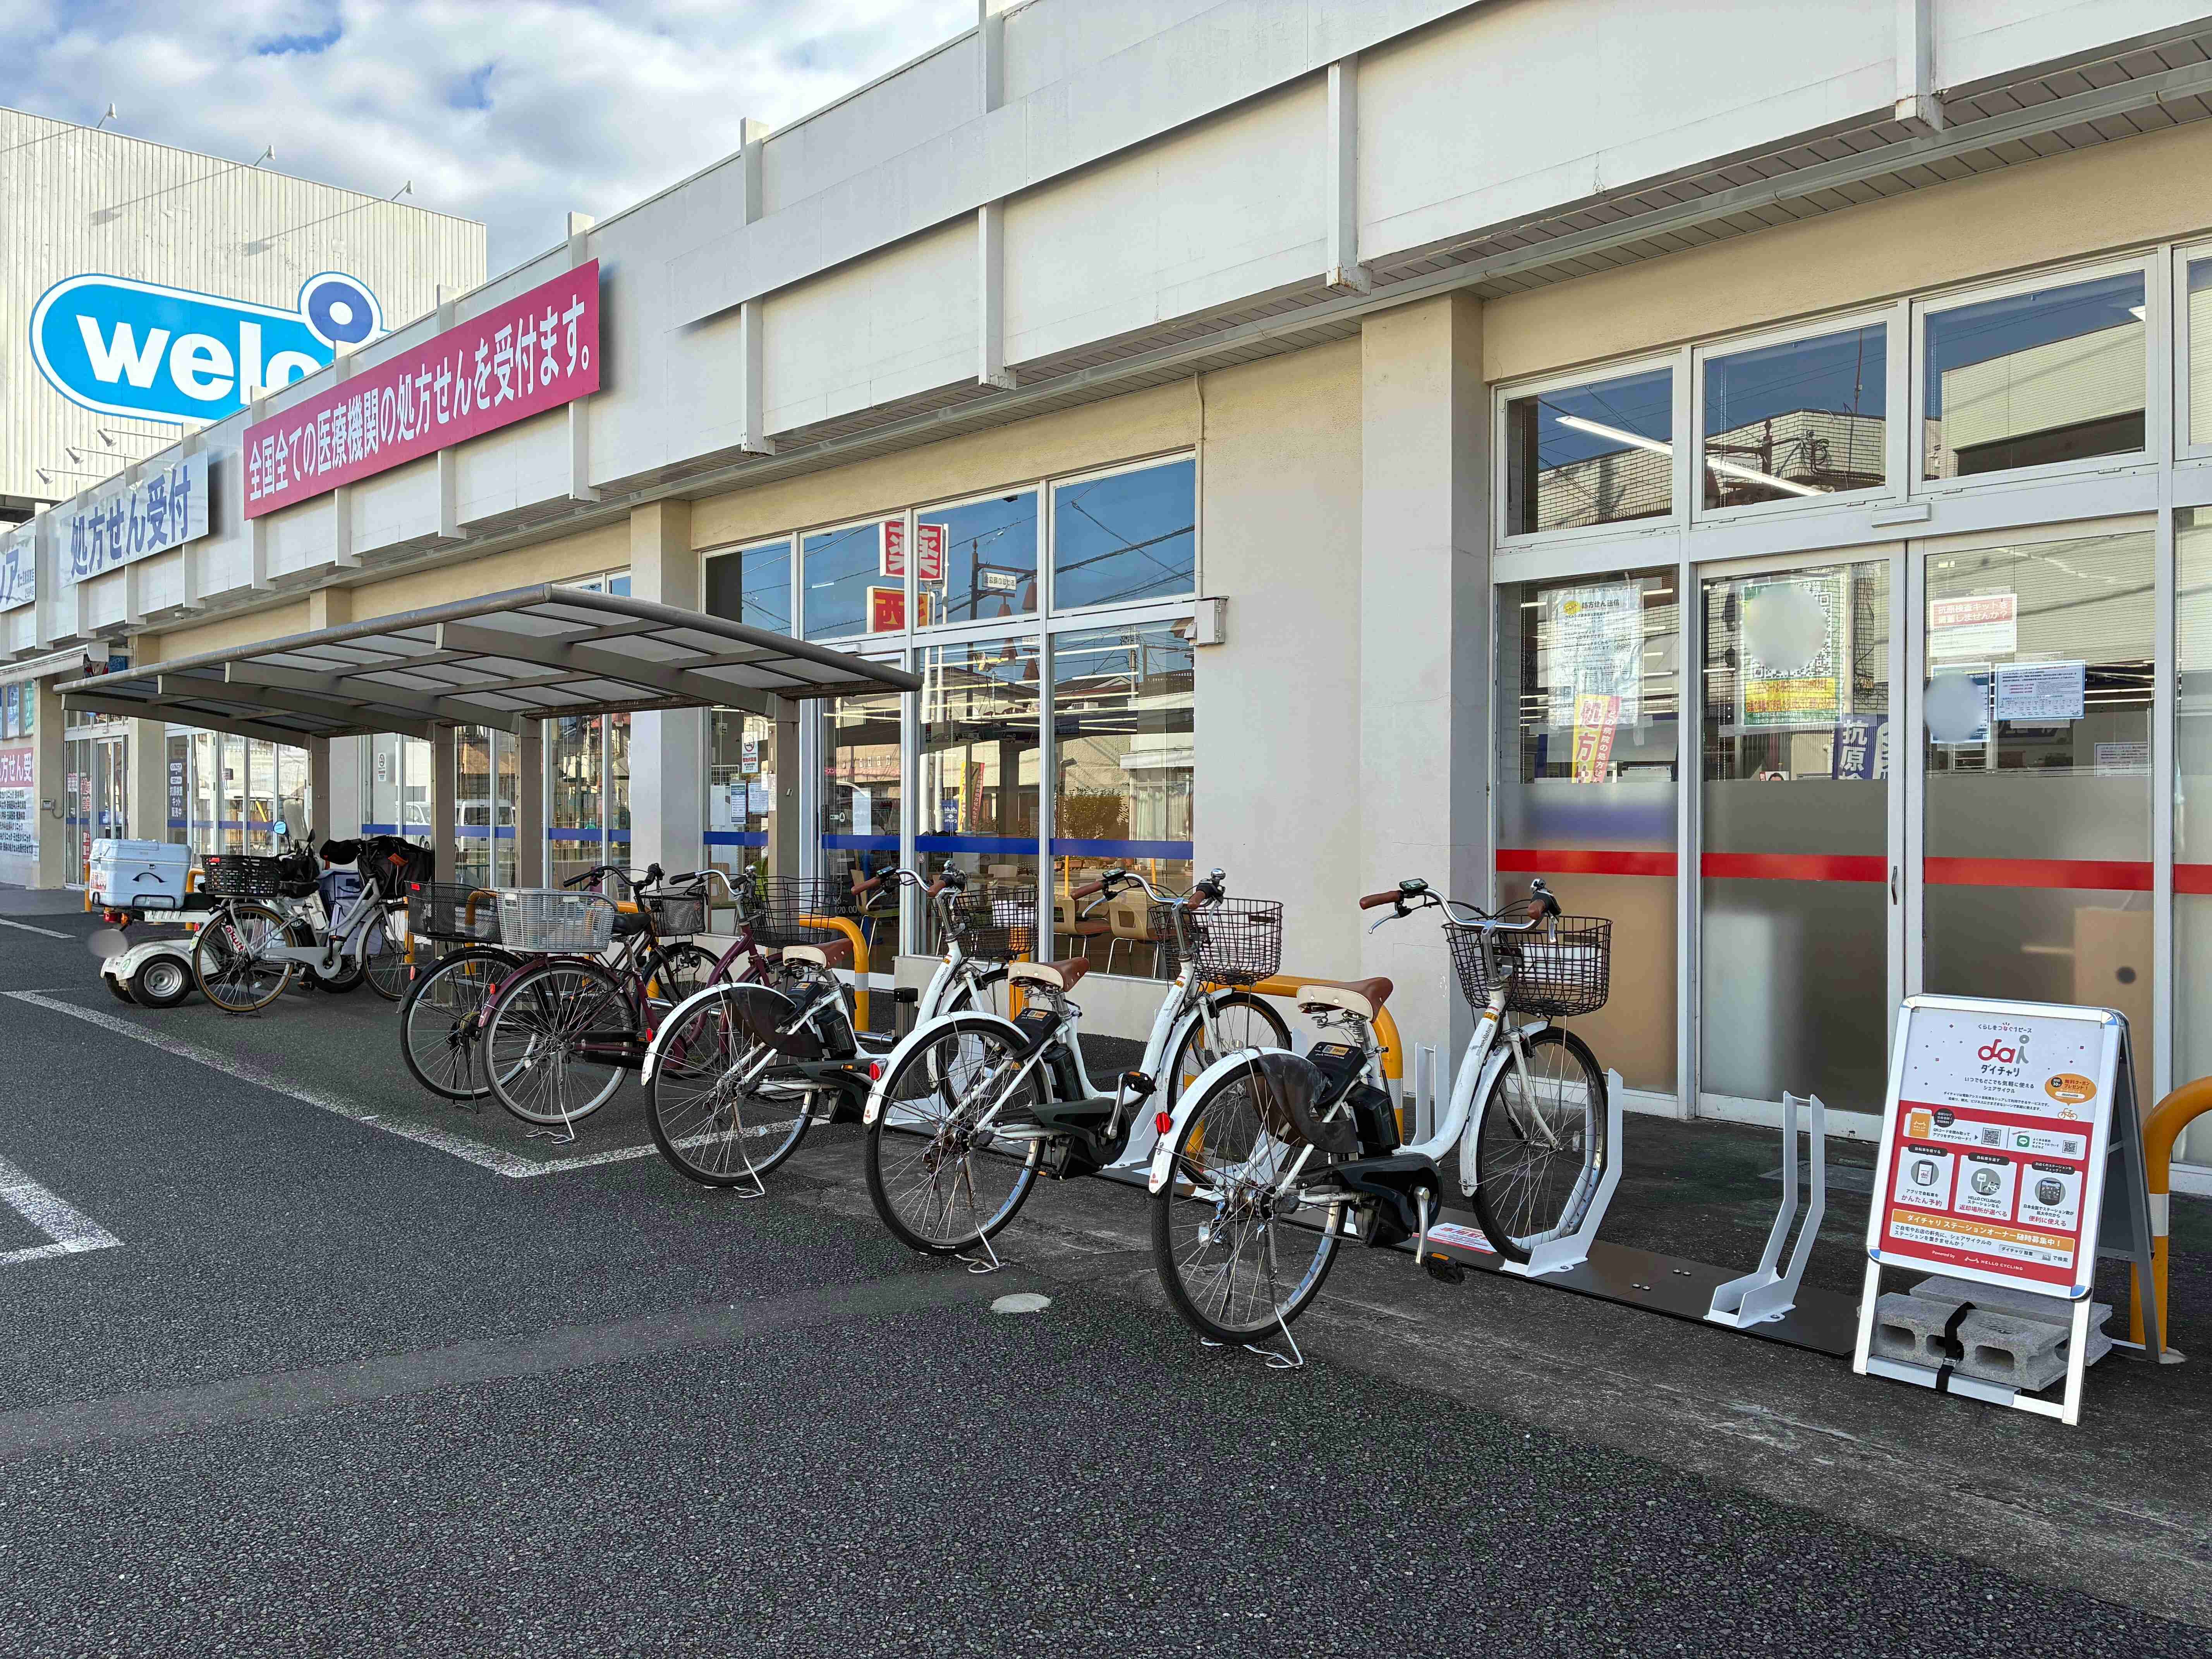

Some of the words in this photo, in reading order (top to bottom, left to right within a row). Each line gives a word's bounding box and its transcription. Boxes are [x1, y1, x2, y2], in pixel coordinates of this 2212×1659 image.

[250, 294, 589, 501] 全国全ての医療機関の処方せんを受付ます。
[71, 465, 191, 579] 処方せん受付
[0, 753, 33, 782] 方せん受
[1978, 1024, 2032, 1033] くらしをつなぐ1ピース
[1981, 1064, 2020, 1077] ダイチャリ
[1965, 1077, 2034, 1089] いつでもどこでも気軽に使える
[1906, 1188, 1938, 1197] アプリで自転車を
[1901, 1194, 1942, 1207] かんたん予約
[1968, 1200, 1999, 1208] ステーションなら
[1959, 1204, 2008, 1217] 返却場所が選べる
[1908, 1214, 1941, 1226] ダイチャリ
[2029, 1216, 2066, 1226] 便利に使える
[1894, 1230, 1964, 1247] ステーションを置きませんか？
